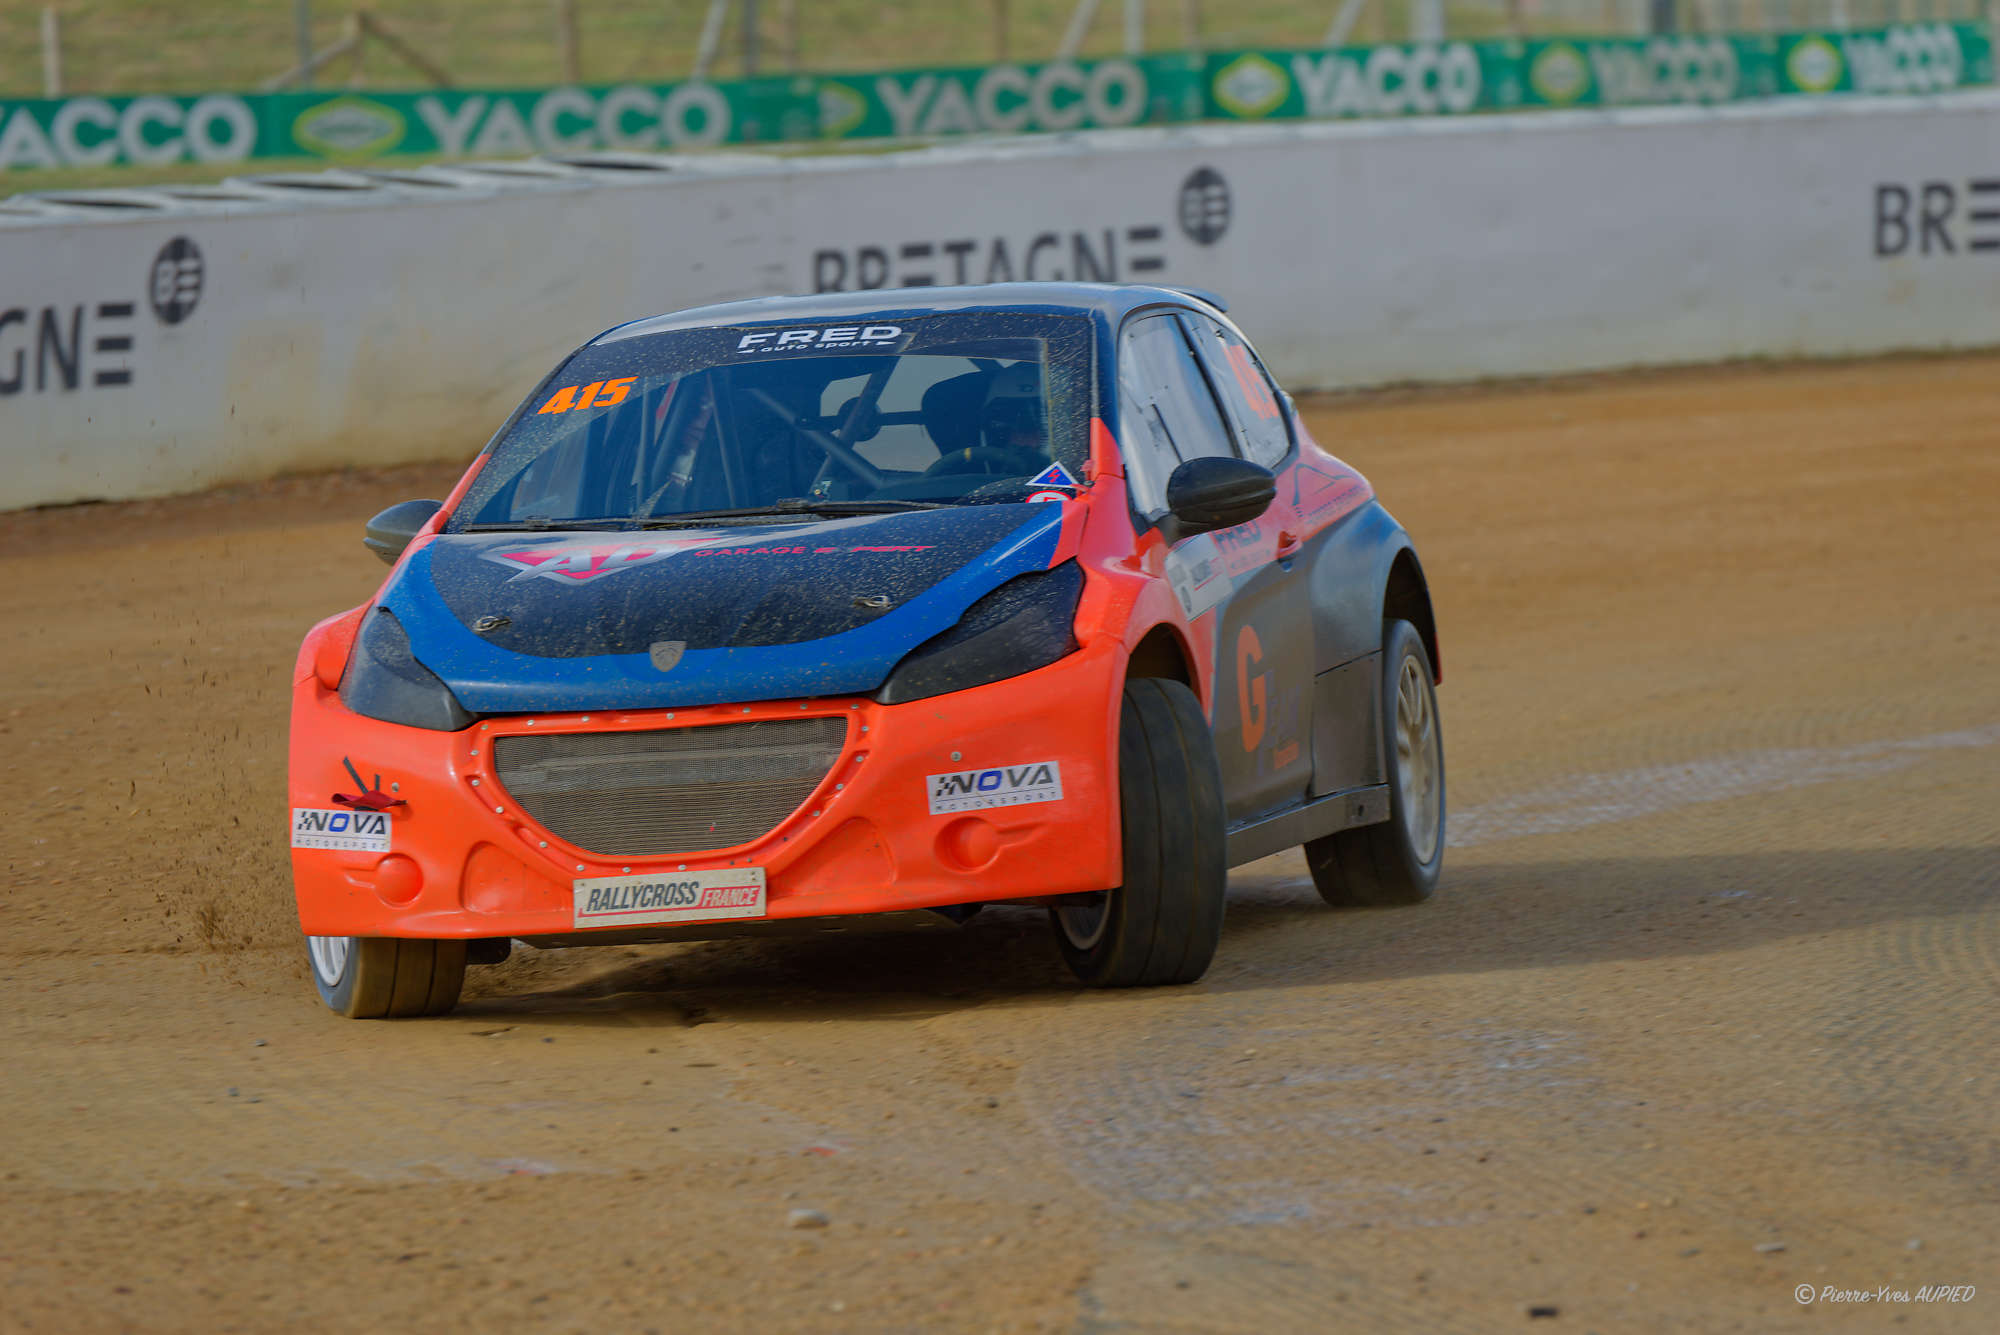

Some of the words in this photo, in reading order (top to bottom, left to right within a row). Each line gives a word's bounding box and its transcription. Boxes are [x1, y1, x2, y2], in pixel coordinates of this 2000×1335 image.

[875, 61, 1148, 137] YACCO
[1290, 43, 1481, 117] YACCO
[0, 93, 259, 168] ACCO
[414, 83, 731, 154] YACCO
[1874, 183, 2000, 256] BRE
[0, 303, 135, 395] GNE
[737, 326, 901, 348] FRED
[760, 344, 808, 353] auto
[814, 340, 871, 350] sport
[537, 376, 639, 414] 415
[694, 546, 807, 557] GARAGE
[936, 765, 1054, 796] NOVA
[298, 811, 387, 835] NOVA
[586, 881, 700, 912] RALLYCROSS
[702, 886, 760, 907] FRANCE
